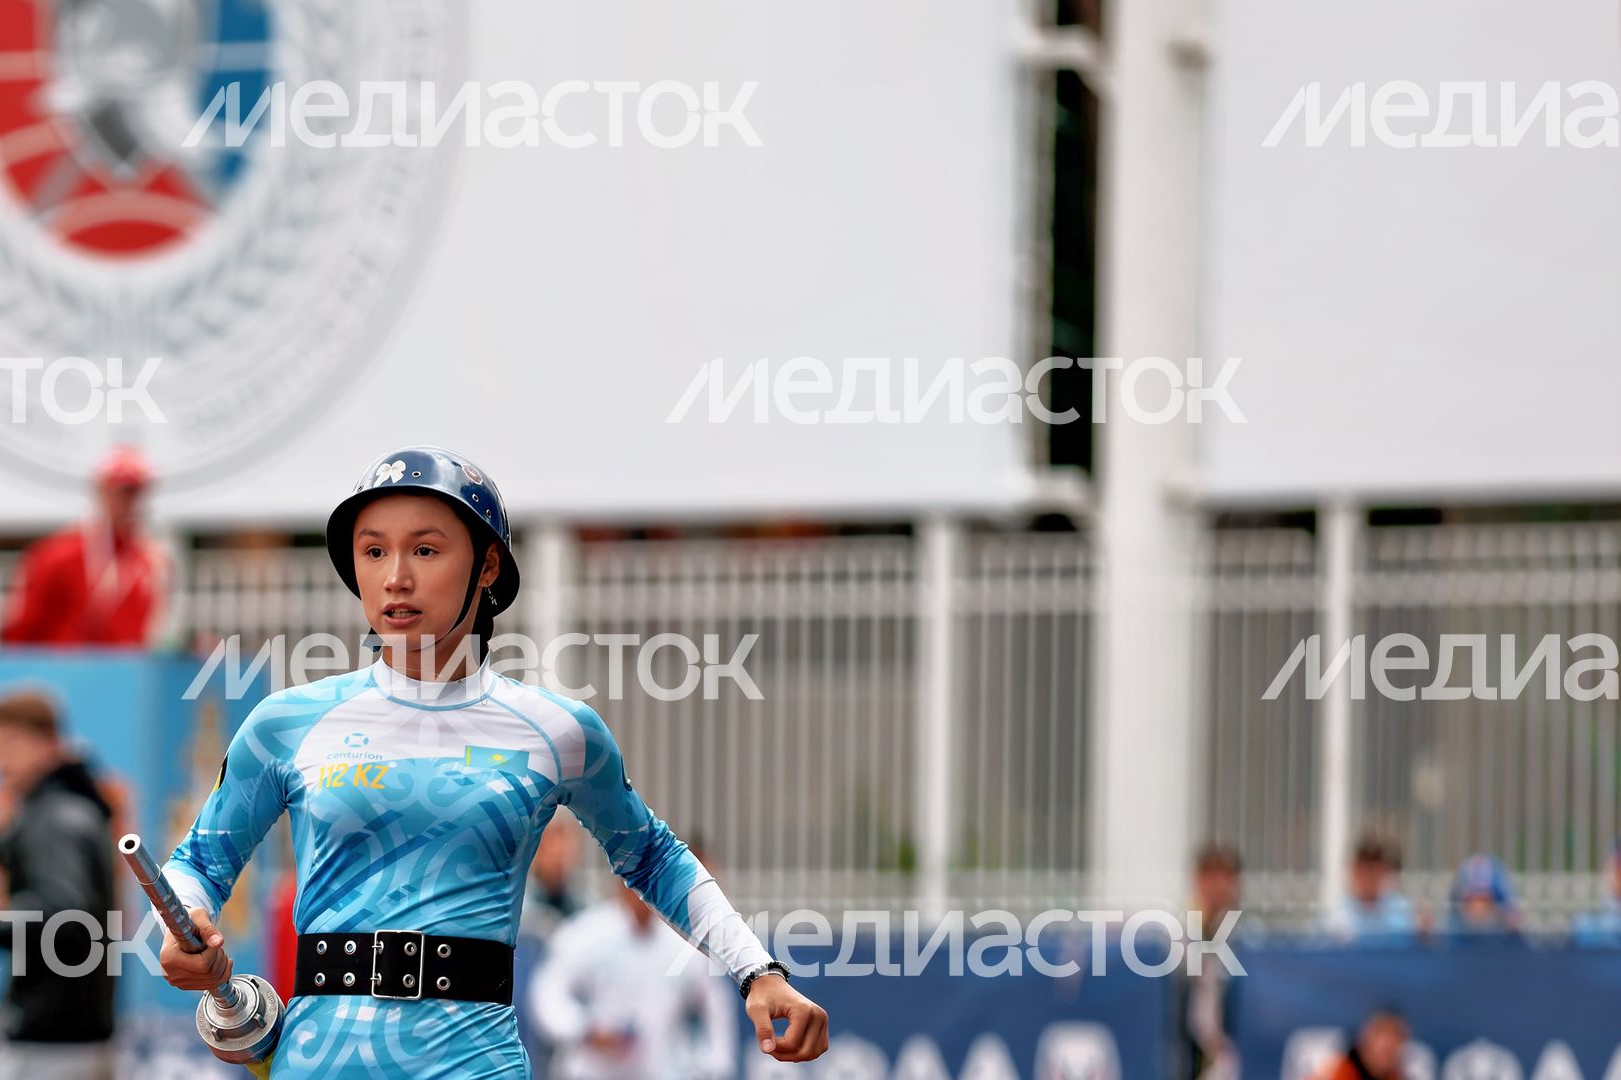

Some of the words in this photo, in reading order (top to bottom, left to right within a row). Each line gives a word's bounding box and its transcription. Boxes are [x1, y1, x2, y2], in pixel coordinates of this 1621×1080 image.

[326, 751, 384, 761] centurion
[317, 763, 348, 790] 112
[353, 763, 389, 790] KZ
